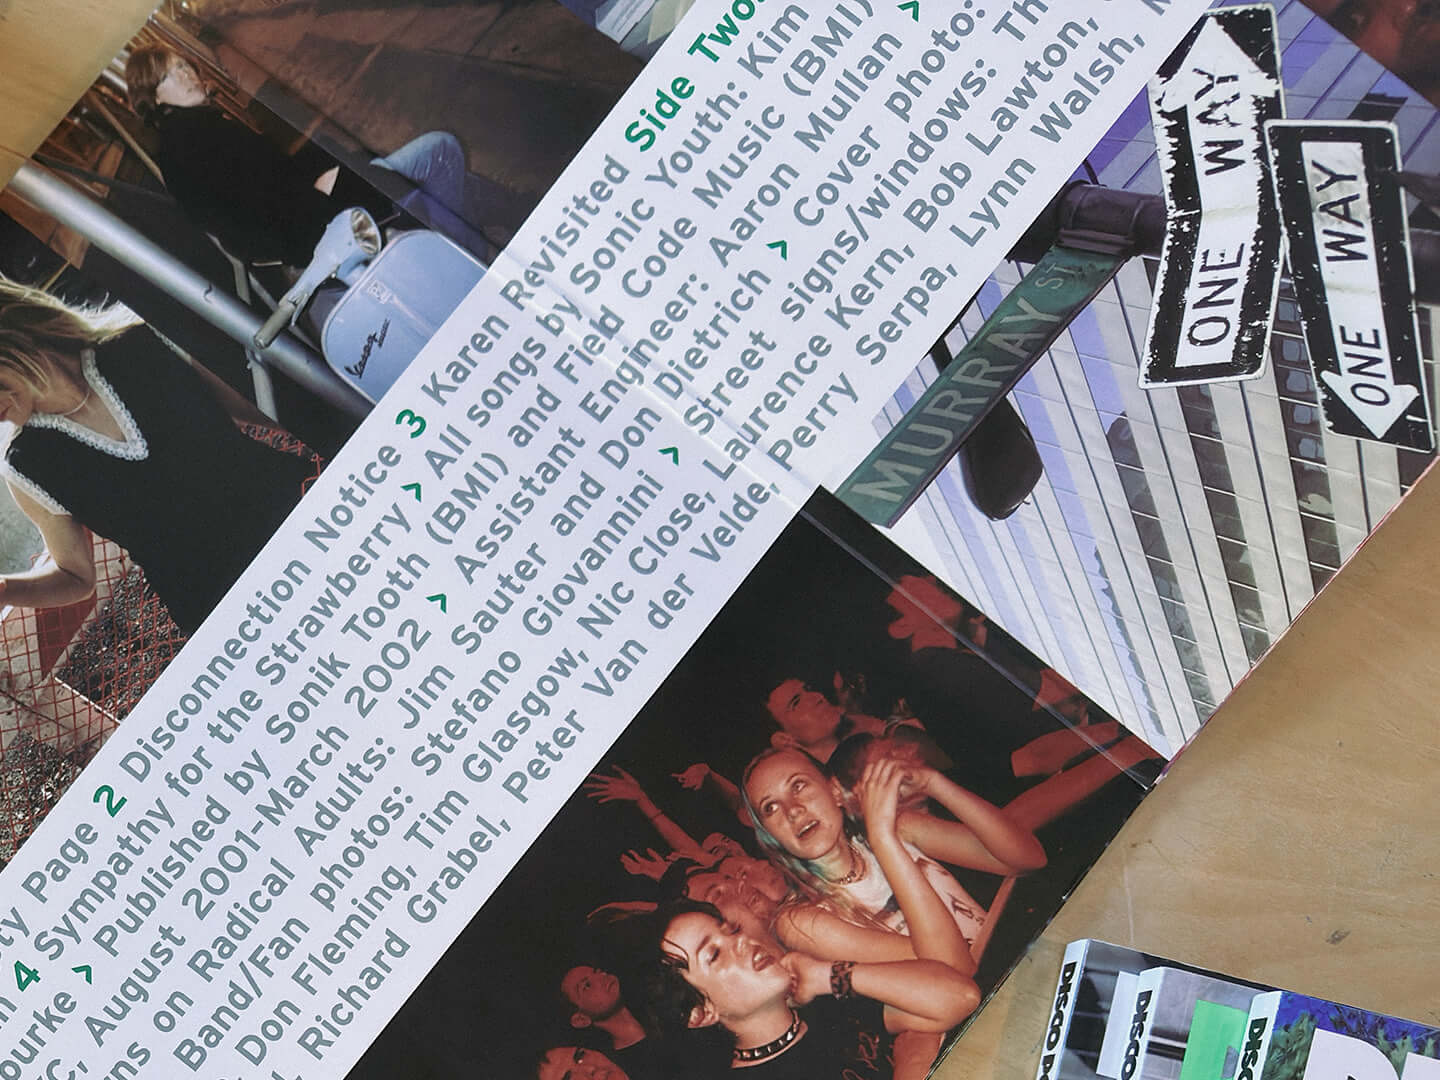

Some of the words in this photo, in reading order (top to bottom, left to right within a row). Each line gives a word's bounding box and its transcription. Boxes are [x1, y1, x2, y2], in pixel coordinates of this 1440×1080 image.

[12, 959, 41, 992] 4
[32, 795, 176, 961] Sympathy
[163, 744, 213, 798] for
[206, 689, 263, 744] the
[254, 501, 411, 686] Strawberry
[424, 422, 472, 480] All
[465, 335, 546, 428] songs
[534, 293, 583, 338] by
[568, 197, 655, 295] Sonic
[644, 80, 748, 189] Youth:
[735, 3, 810, 80] Kim
[20, 822, 99, 904] Page
[92, 783, 128, 818] 2
[117, 558, 312, 783] Disconnection
[303, 444, 402, 553] Notice
[394, 408, 427, 439] 3
[419, 314, 510, 406] Karen
[498, 153, 630, 312] Revisited
[623, 75, 695, 152] Side
[686, 0, 764, 63] Two
[83, 924, 186, 1048] August
[180, 725, 349, 920] 2001-March
[343, 618, 431, 719] 2002
[453, 426, 586, 585] Assistant
[577, 272, 709, 424] Engineer:
[708, 162, 800, 268] Aaron
[792, 32, 903, 152] Mullan
[91, 793, 231, 958] Published
[222, 748, 271, 796] by
[264, 651, 351, 744] Sonik
[339, 552, 430, 642] Tooth
[424, 451, 508, 545] (BMI)
[506, 382, 562, 448] and
[552, 303, 625, 384] Field
[621, 216, 697, 298] Code
[690, 105, 785, 210] Music
[782, 0, 874, 97] (BMI)
[152, 990, 194, 1033] on
[186, 856, 296, 983] Radical
[293, 736, 396, 857] Adults:
[396, 664, 455, 729] Jim
[450, 541, 547, 655] Sauter
[549, 469, 606, 536] and
[597, 406, 662, 470] Don
[652, 268, 772, 400] Dietrich
[792, 124, 880, 226] Cover
[883, 0, 986, 124] photo:
[172, 917, 310, 1072] Band/Fan
[308, 785, 413, 912] photos:
[410, 650, 521, 777] Stefano
[521, 468, 664, 636] Giovannini
[682, 329, 777, 436] Street
[780, 58, 997, 322] signs/windows:
[233, 999, 302, 1066] Don
[290, 864, 418, 996] Fleming,
[402, 789, 469, 849] Tim
[461, 646, 590, 783] Glasgow,
[575, 580, 634, 639] Nic
[627, 490, 716, 575] Close,
[701, 334, 832, 482] Laurence
[823, 243, 915, 331] Kern,
[901, 161, 972, 233] Bob
[963, 16, 1099, 156] Lawton,
[295, 927, 411, 1060] Richard
[406, 813, 511, 923] Grabel,
[501, 708, 585, 804] Peter
[580, 638, 648, 697] Van
[647, 572, 695, 630] der
[688, 481, 780, 562] Velde,
[764, 371, 859, 472] Perry
[854, 262, 958, 365] Serpa,
[948, 157, 1036, 248] Lynn
[1028, 33, 1145, 143] Walsh,
[850, 296, 1061, 502] MURRAY
[1034, 265, 1076, 291] ST
[1187, 242, 1246, 348] ONE
[1192, 67, 1247, 177] WAY
[1310, 159, 1369, 263] WAY
[1339, 324, 1391, 408] ONE
[1046, 961, 1077, 1051] DISCO
